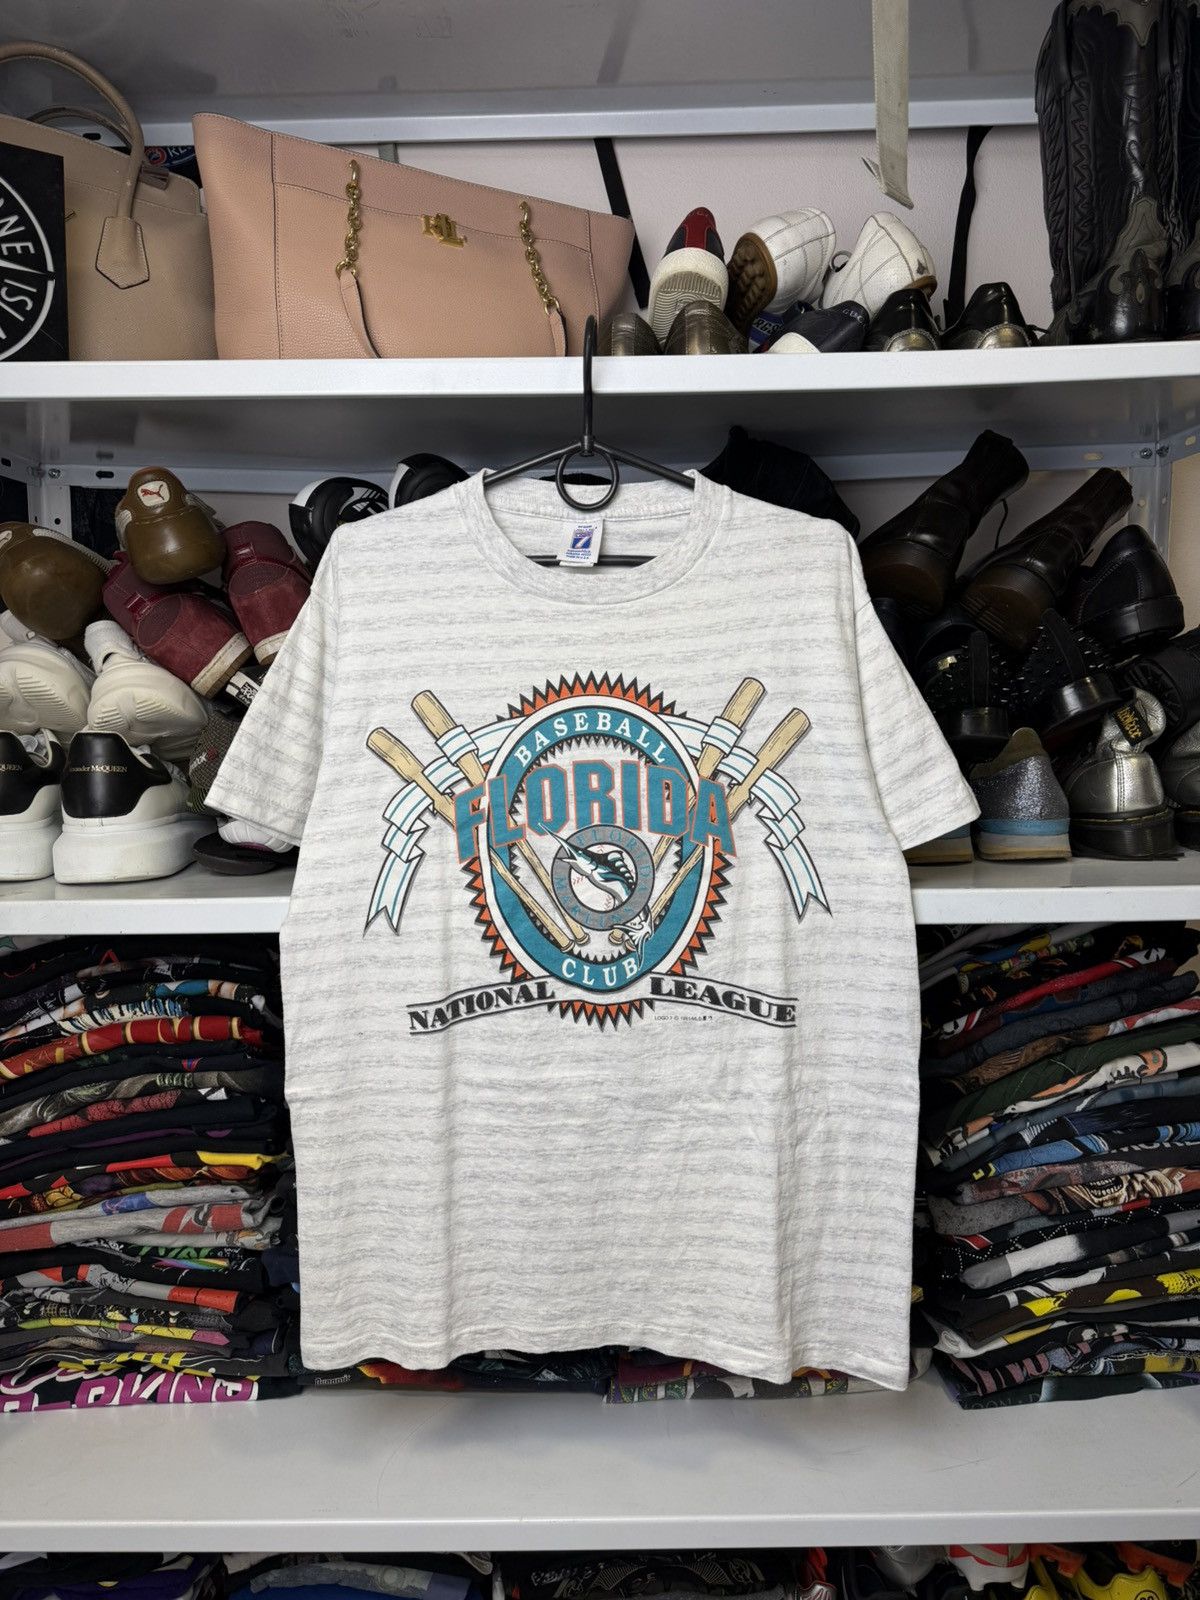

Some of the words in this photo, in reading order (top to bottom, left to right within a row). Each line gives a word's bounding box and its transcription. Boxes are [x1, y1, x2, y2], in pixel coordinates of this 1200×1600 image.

[513, 711, 669, 768] BASEBALL
[453, 759, 738, 865] FLORIDA
[575, 828, 650, 893] FLORIDA
[561, 956, 639, 987] CLUB
[408, 980, 556, 1031] NATIONAL
[650, 976, 796, 1021] LEAGUE
